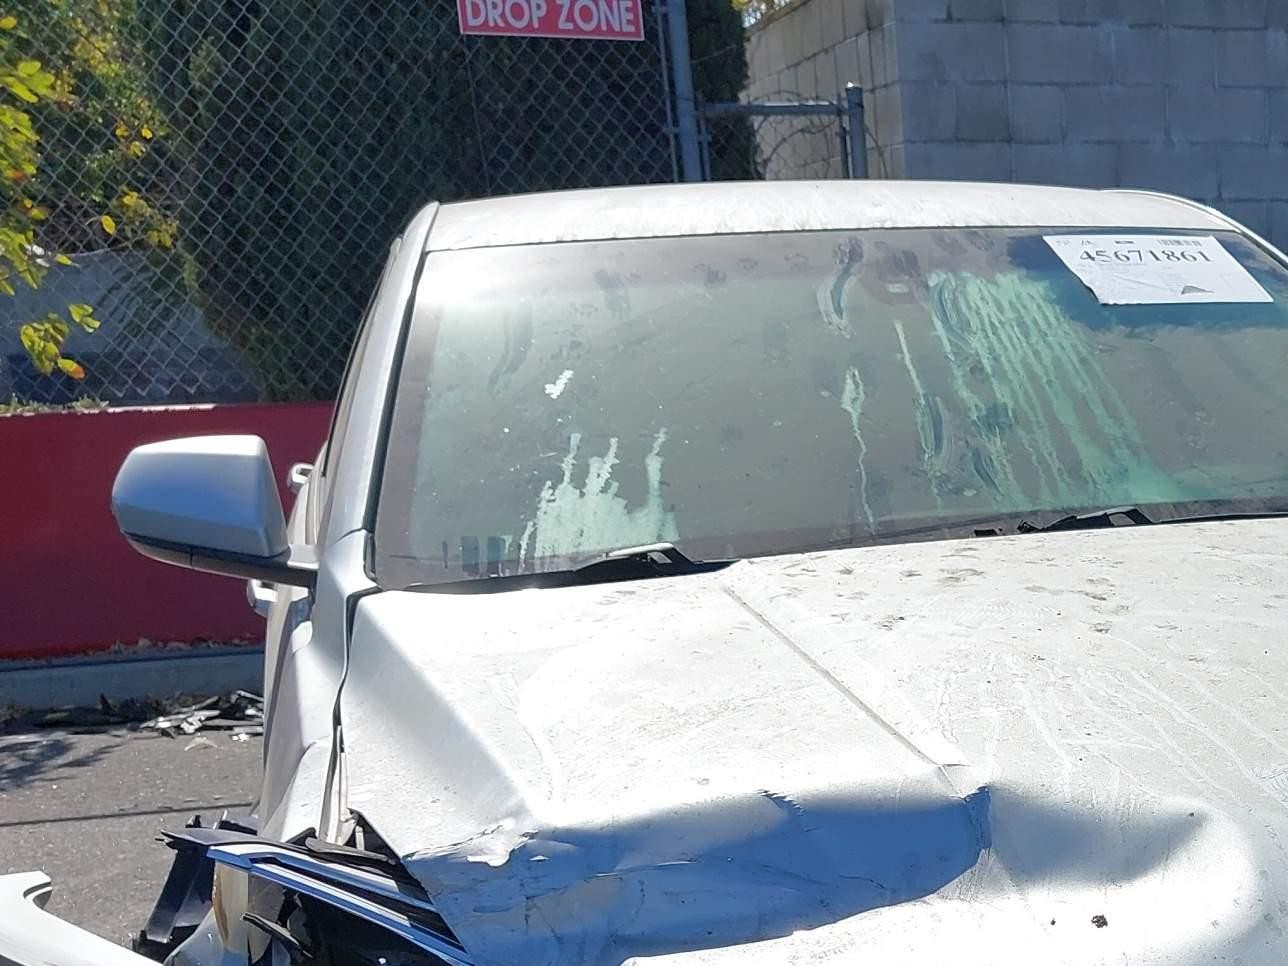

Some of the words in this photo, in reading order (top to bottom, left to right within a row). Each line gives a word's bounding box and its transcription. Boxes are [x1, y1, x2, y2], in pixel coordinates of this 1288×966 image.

[465, 0, 547, 29] DROP
[557, 0, 636, 32] ZONE
[1079, 249, 1213, 263] 45671861
